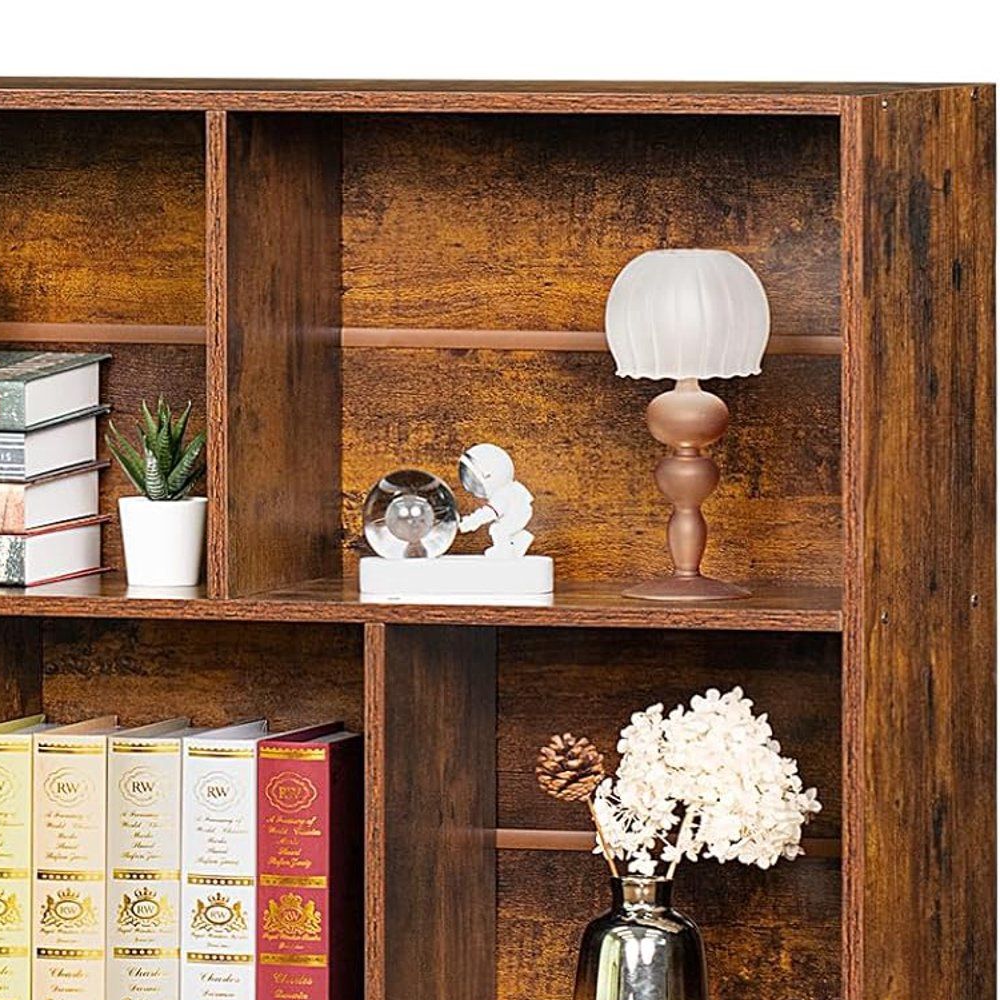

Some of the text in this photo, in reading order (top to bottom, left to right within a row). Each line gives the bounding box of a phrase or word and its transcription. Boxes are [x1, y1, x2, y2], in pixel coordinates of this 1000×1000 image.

[56, 782, 79, 794] RW
[131, 781, 154, 793] RW
[206, 786, 229, 799] RW
[136, 904, 155, 914] RW
